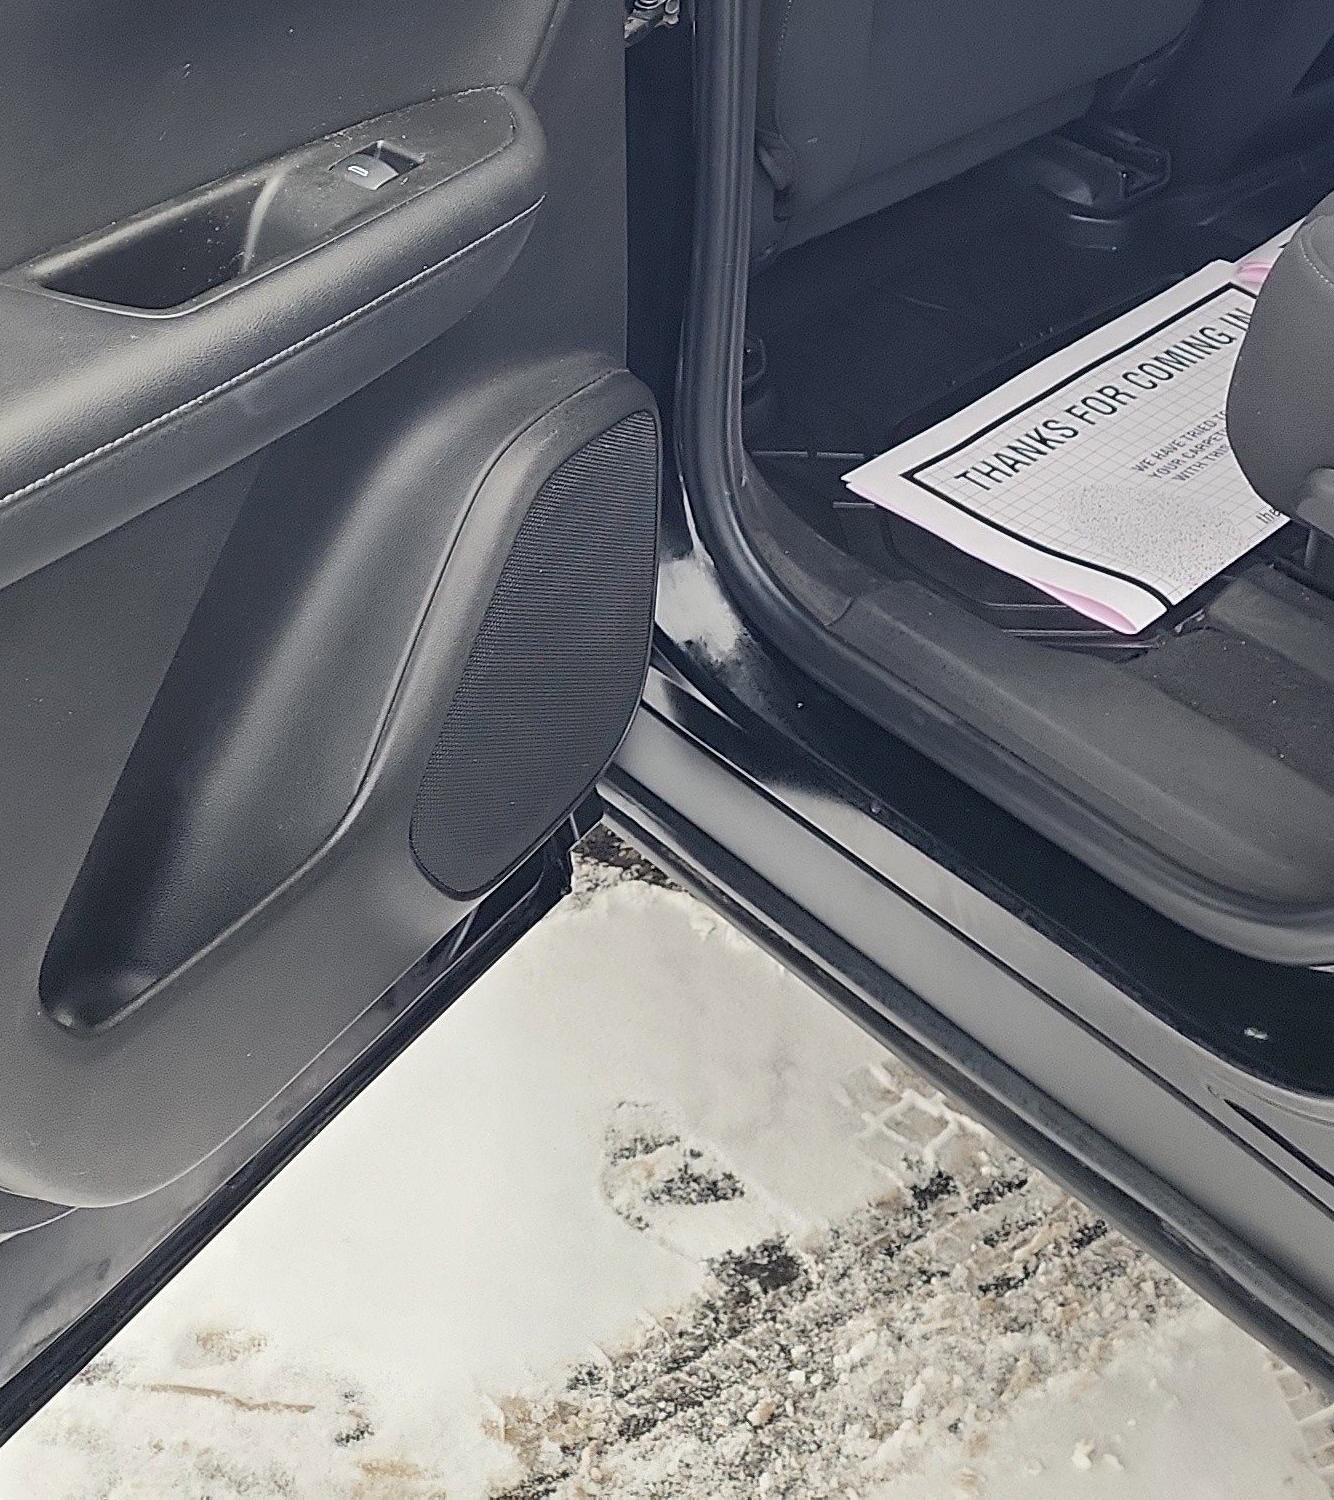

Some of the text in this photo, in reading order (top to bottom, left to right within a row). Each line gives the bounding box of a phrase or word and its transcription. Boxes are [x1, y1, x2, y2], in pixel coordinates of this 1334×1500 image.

[954, 419, 1079, 490] THANKS
[1064, 385, 1138, 425] FOR
[1123, 326, 1237, 390] COMING
[1131, 458, 1156, 472] WE
[1151, 439, 1186, 460] HAVE
[1179, 420, 1217, 441] TRIED
[1148, 458, 1187, 478] YOUR
[1172, 461, 1208, 480] WITH
